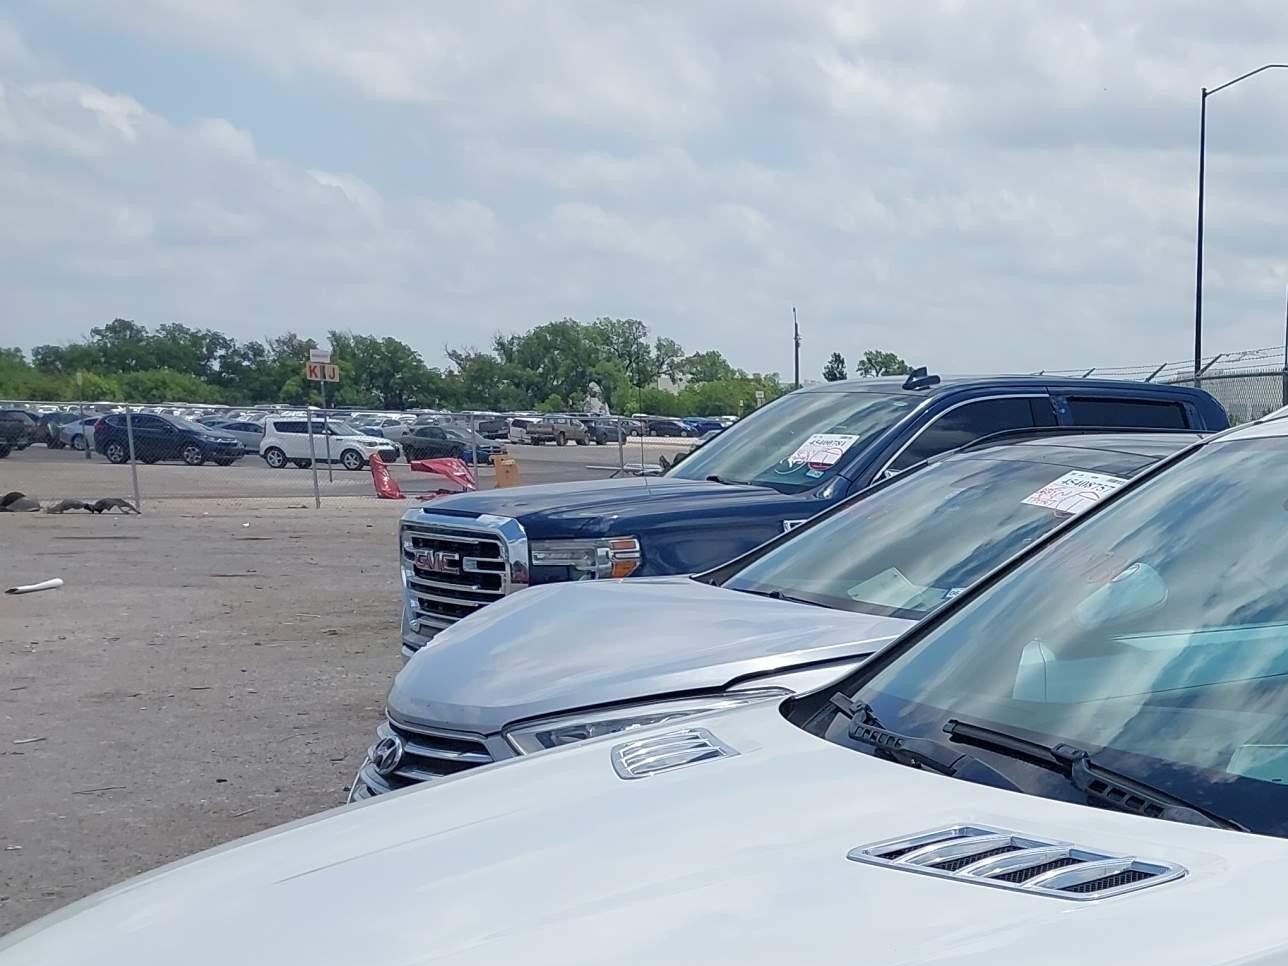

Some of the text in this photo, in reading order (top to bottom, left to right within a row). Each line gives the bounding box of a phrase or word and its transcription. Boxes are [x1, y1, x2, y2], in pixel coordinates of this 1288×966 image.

[309, 365, 319, 379] K
[329, 367, 336, 380] J
[415, 548, 460, 575] GMC
